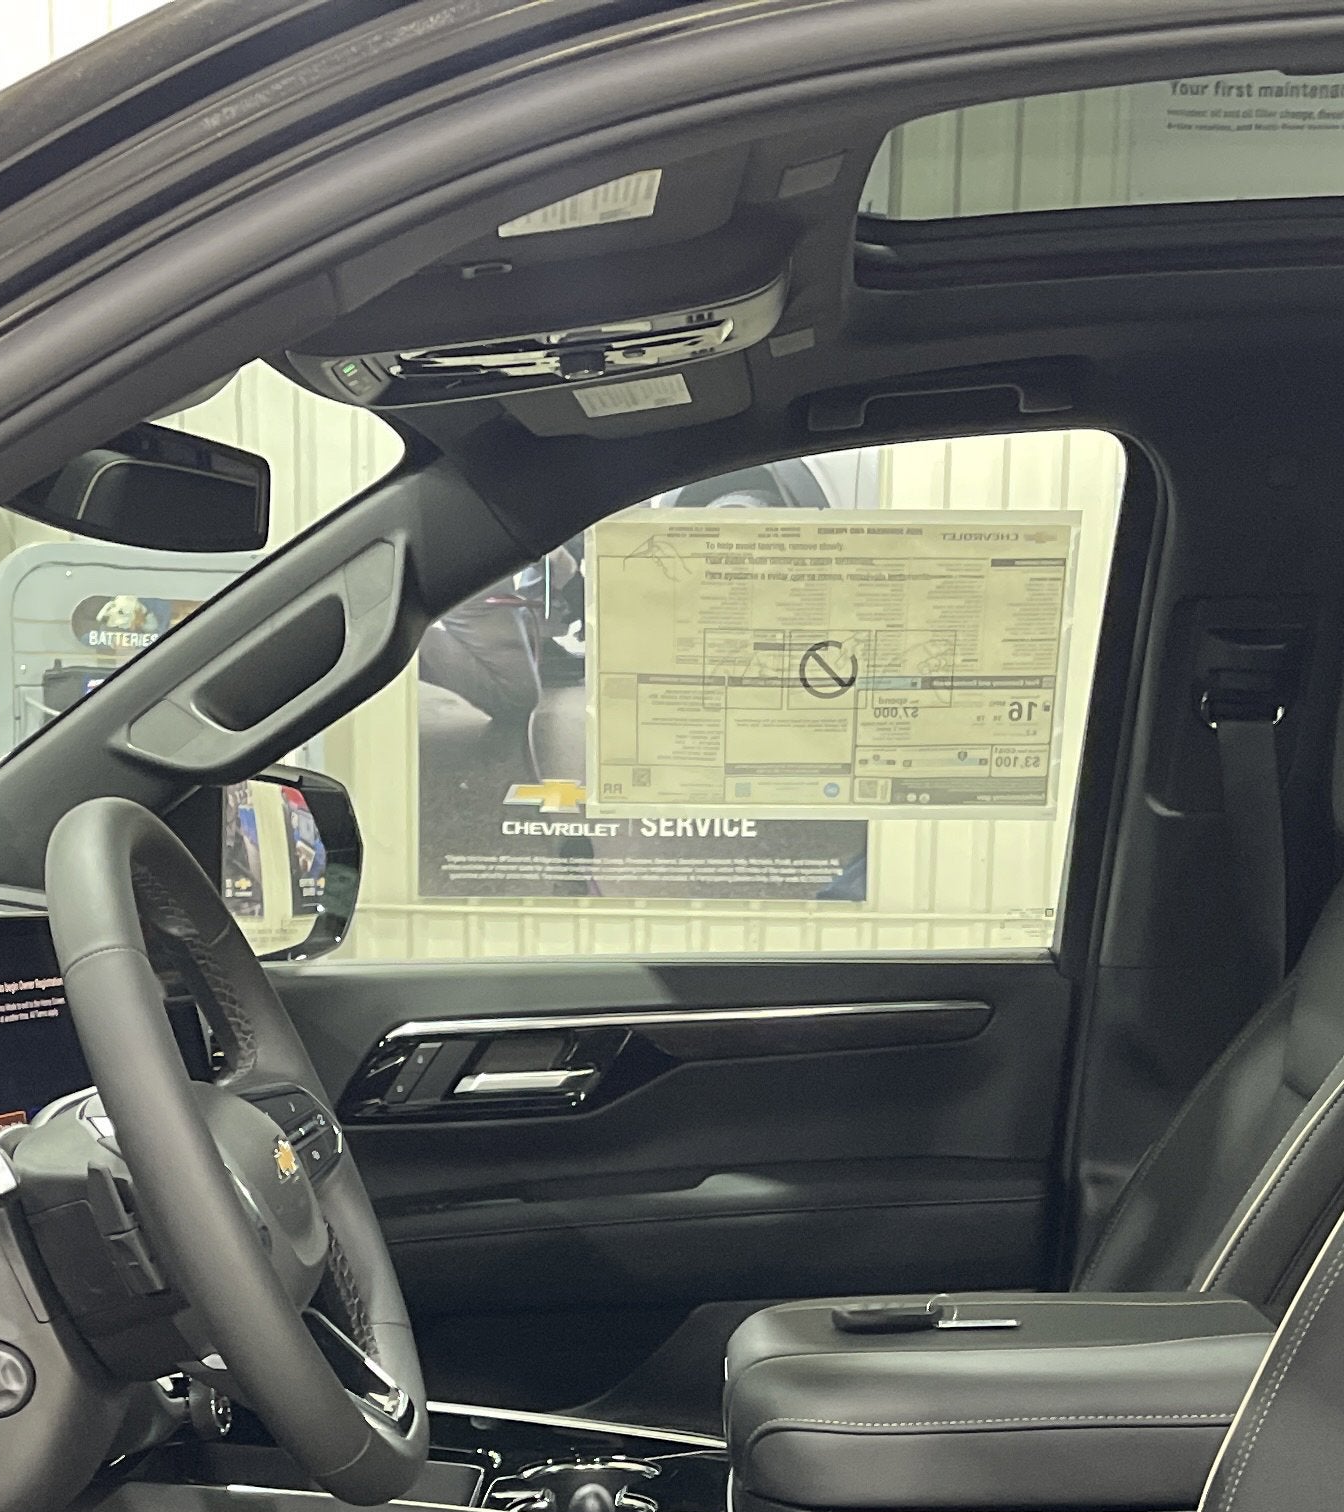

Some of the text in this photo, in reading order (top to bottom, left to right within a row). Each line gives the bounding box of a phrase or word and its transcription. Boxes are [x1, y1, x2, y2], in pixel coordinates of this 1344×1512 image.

[1170, 81, 1208, 97] Your
[1215, 81, 1253, 98] first
[88, 630, 159, 647] BATTERIES
[502, 817, 757, 838] CHEVROLET SERVICE
